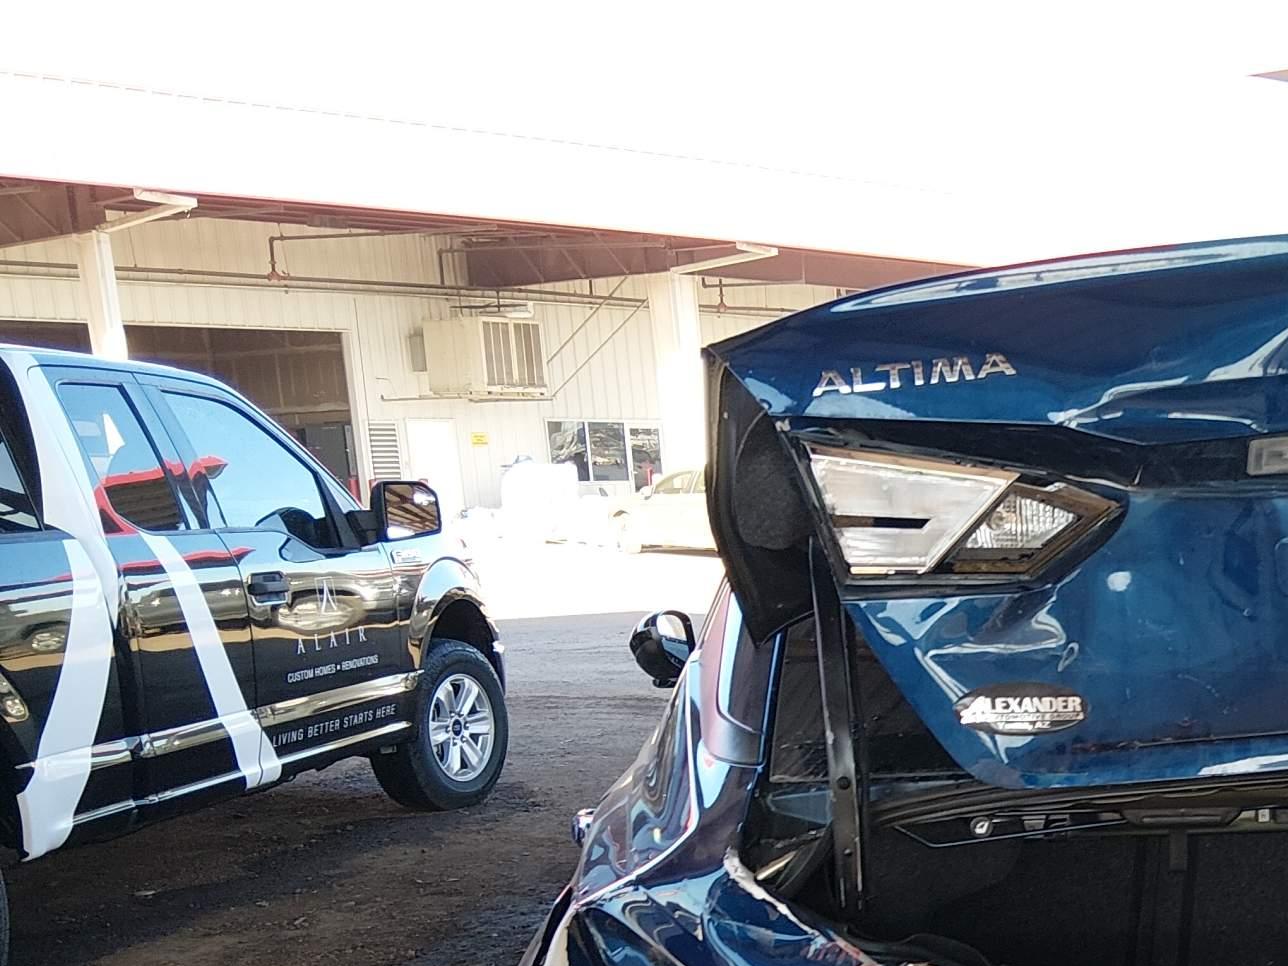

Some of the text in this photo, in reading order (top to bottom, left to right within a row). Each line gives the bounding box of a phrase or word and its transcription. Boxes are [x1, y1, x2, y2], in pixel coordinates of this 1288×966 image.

[812, 353, 1017, 397] ALTIMA
[297, 626, 367, 655] ALAIR
[287, 654, 379, 683] CUSTOM HOMES RENOVATIONS
[272, 703, 398, 748] LIVING BETTER STARTS HERE
